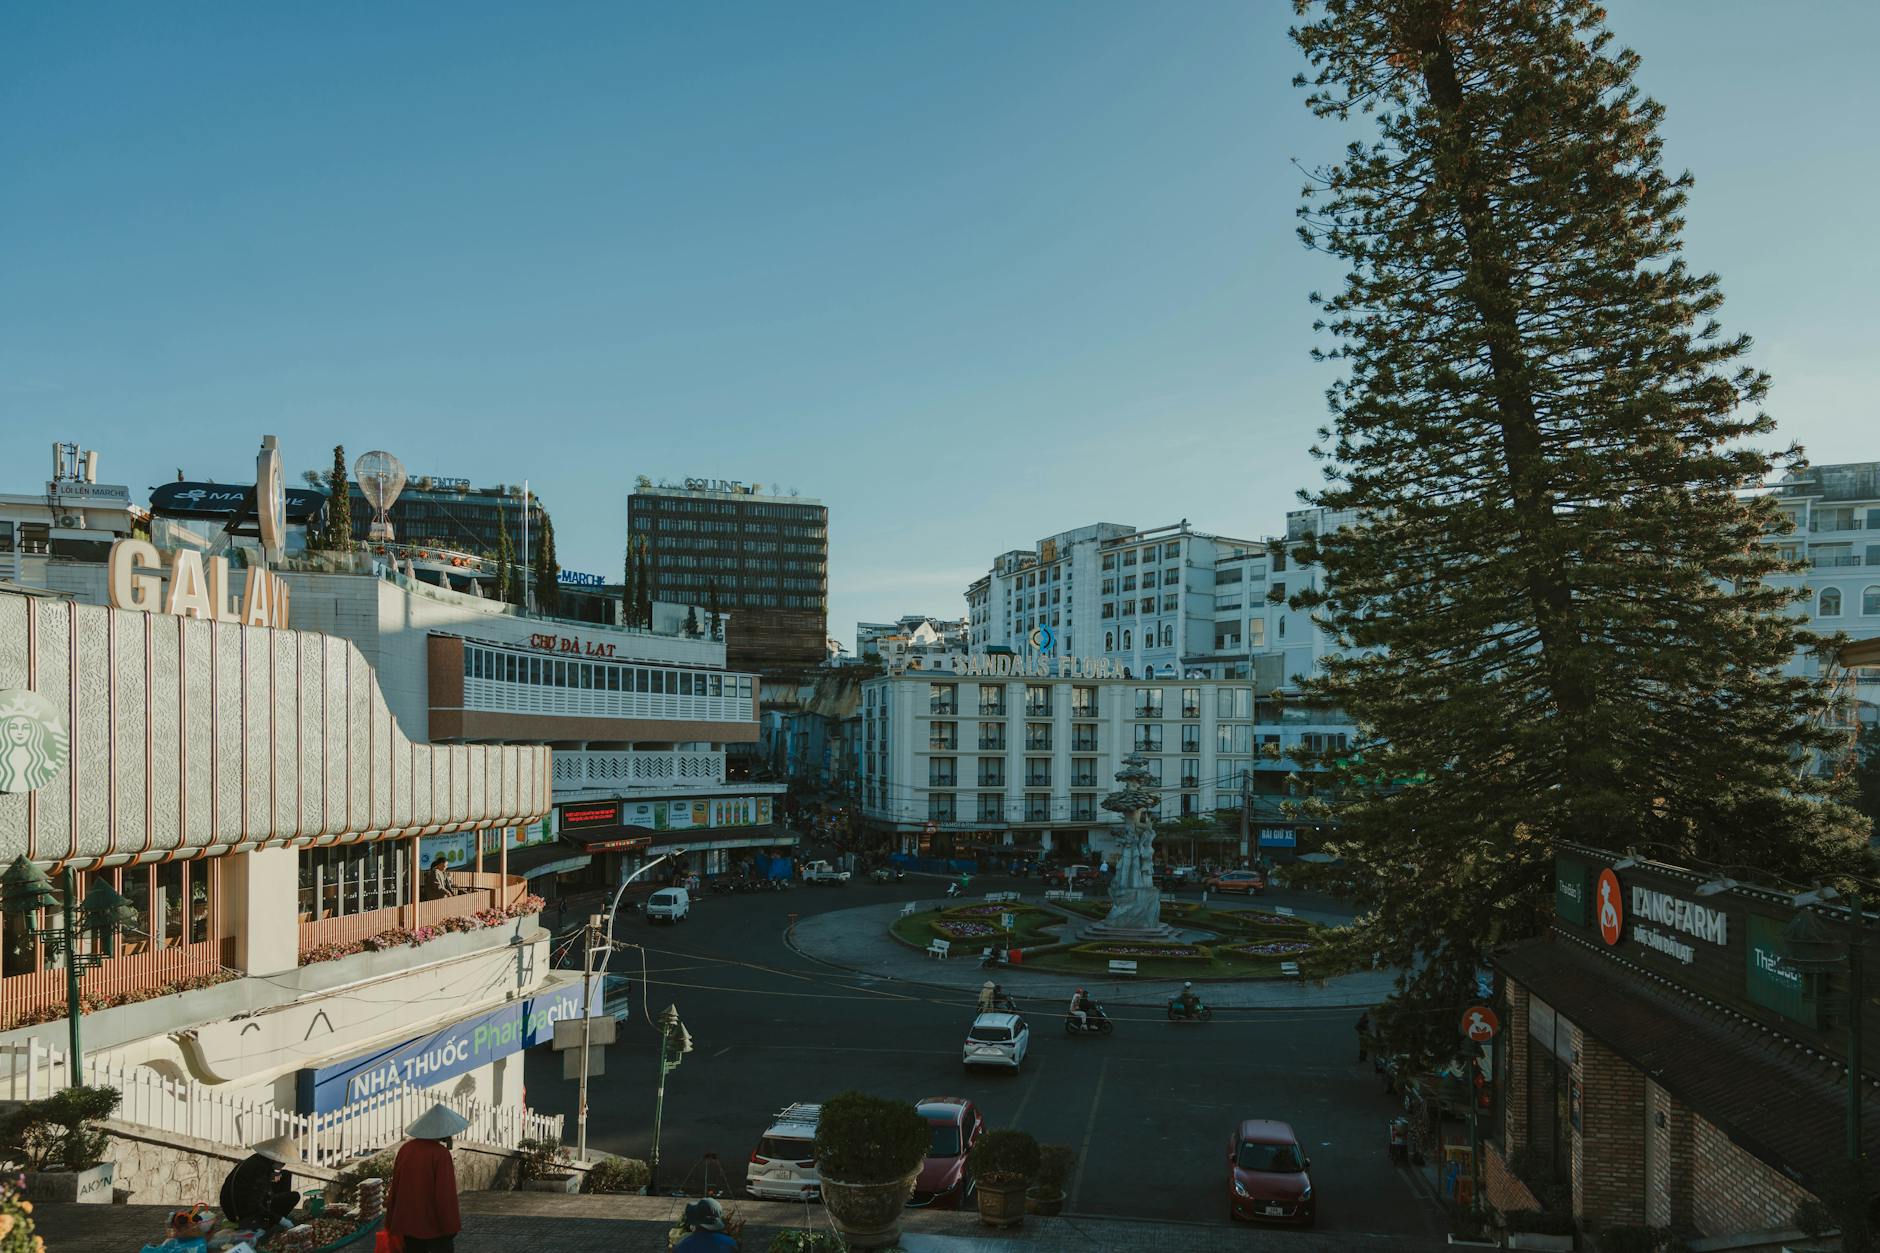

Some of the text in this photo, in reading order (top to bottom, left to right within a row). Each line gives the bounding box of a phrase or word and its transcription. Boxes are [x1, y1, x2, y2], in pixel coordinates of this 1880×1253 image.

[420, 475, 471, 490] ENTER
[108, 537, 290, 630] GALAXY
[954, 653, 1125, 679] SANDALS FLORA
[1285, 829, 1294, 840] XE
[1632, 885, 1728, 946] L'ANGFARM
[353, 1060, 400, 1100] NHÀ
[403, 1036, 469, 1080] THUỐC
